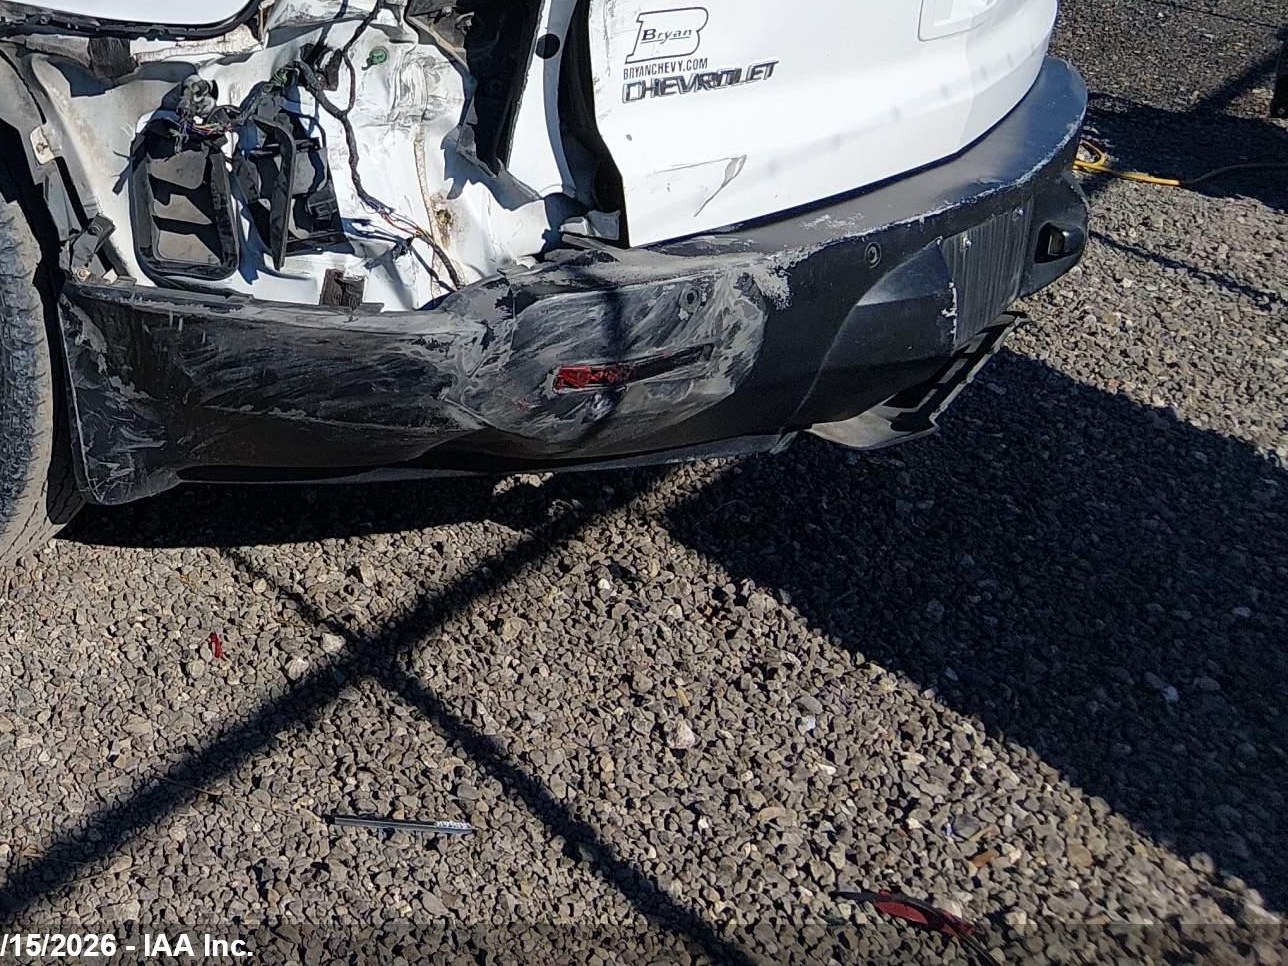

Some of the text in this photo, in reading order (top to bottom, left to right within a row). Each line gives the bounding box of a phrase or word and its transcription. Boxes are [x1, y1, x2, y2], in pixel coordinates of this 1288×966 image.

[640, 28, 693, 45] Bryan
[622, 57, 709, 81] BRYANCHEVY.COM
[621, 60, 780, 104] CHEVROLET
